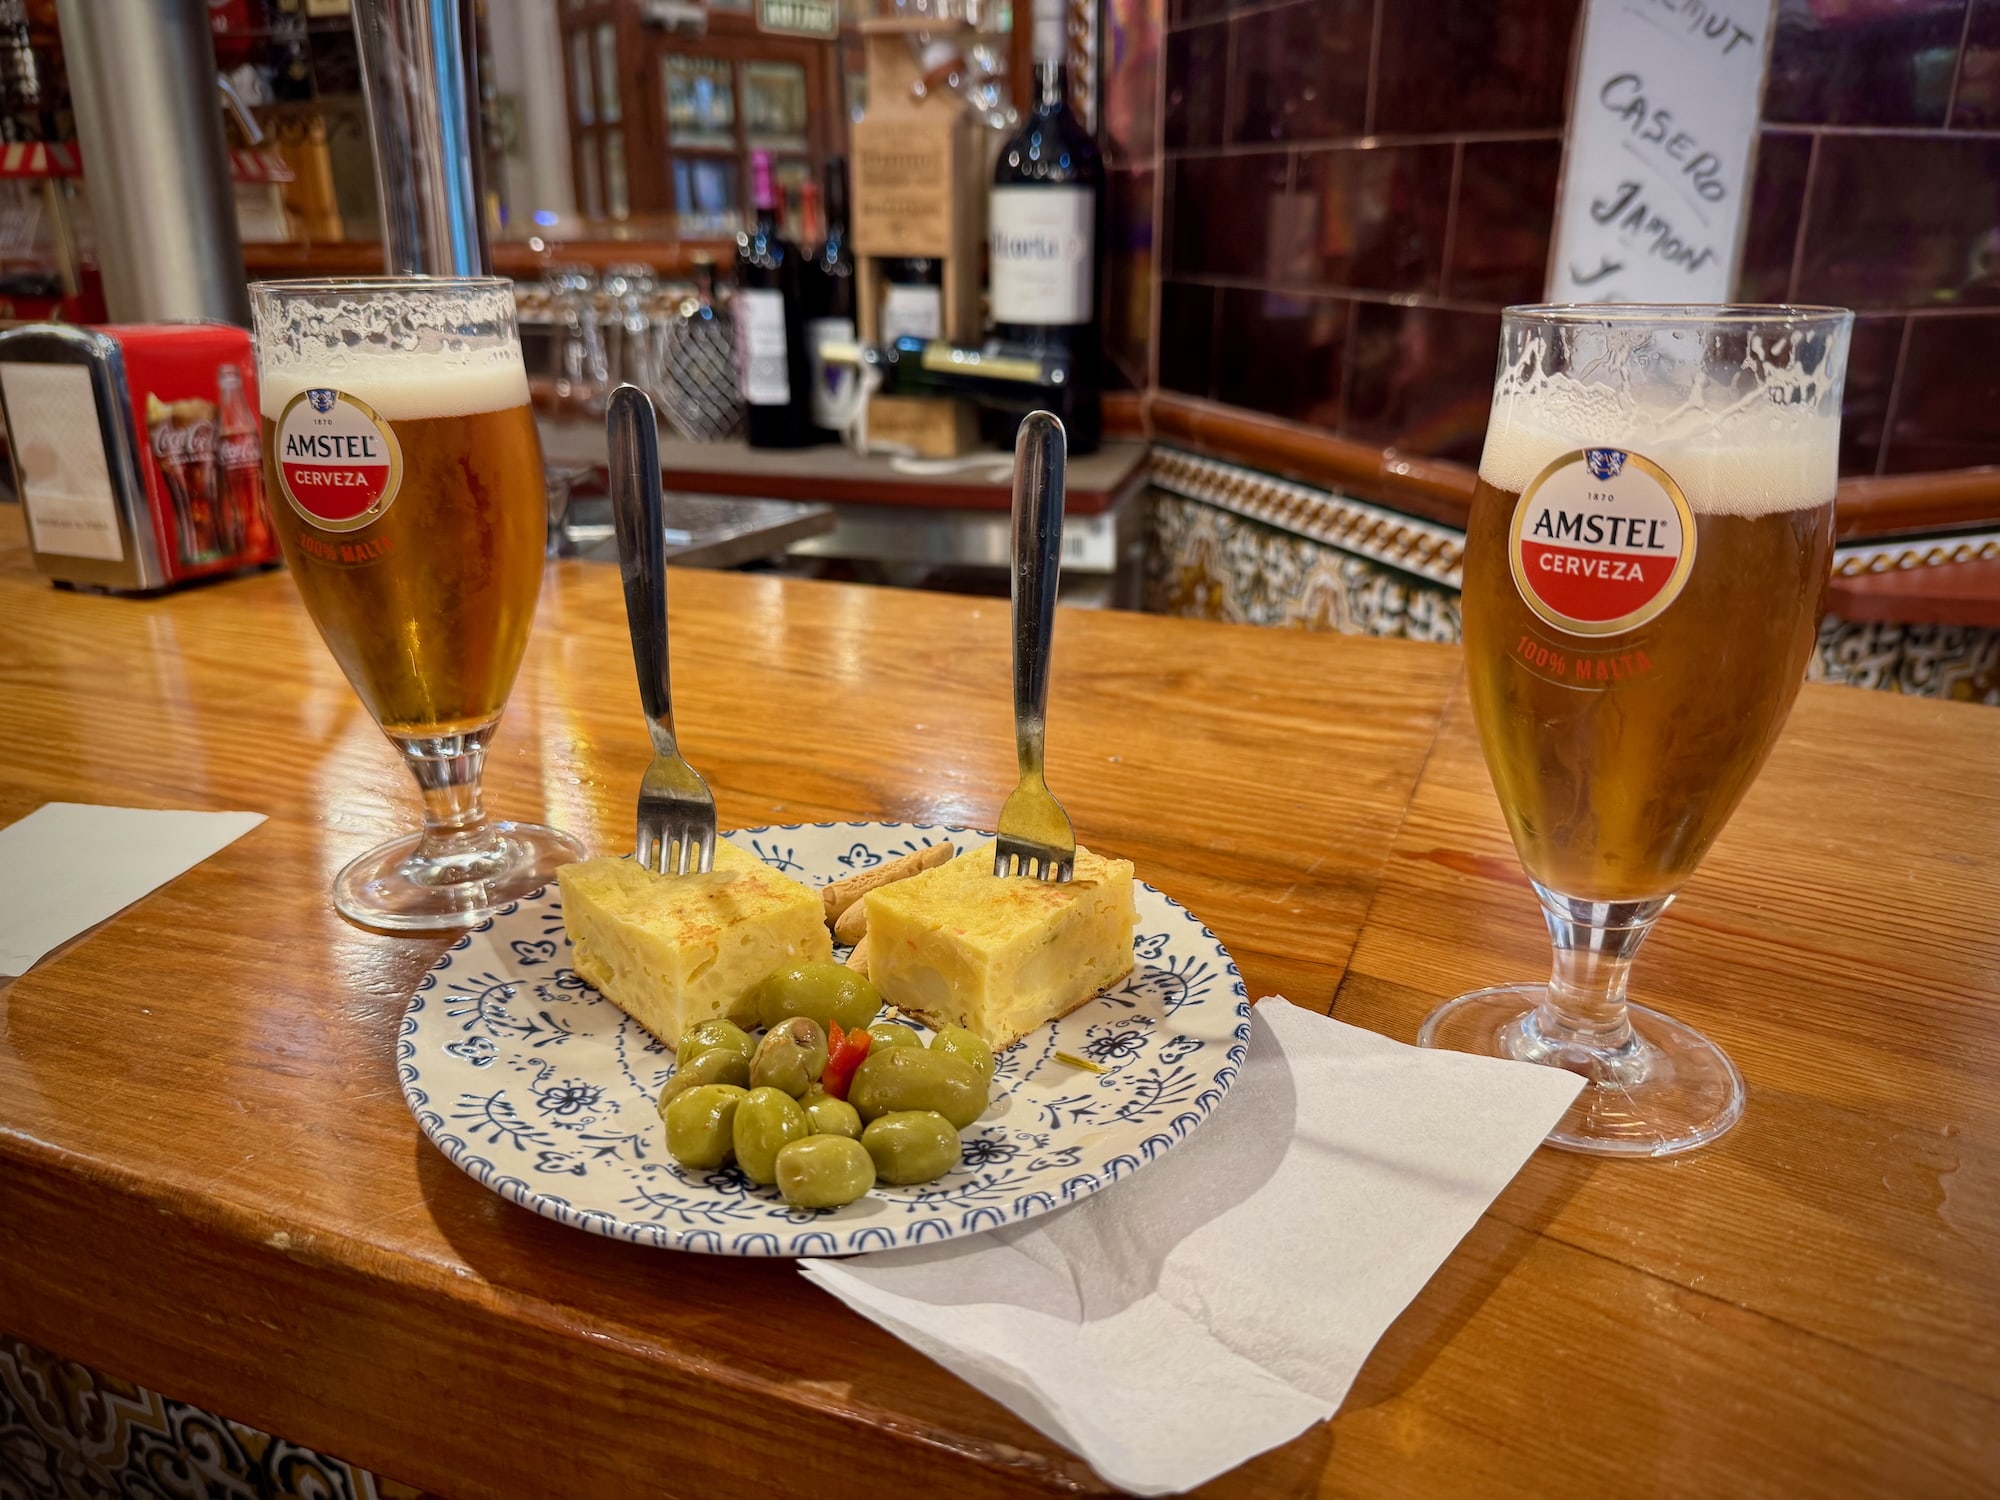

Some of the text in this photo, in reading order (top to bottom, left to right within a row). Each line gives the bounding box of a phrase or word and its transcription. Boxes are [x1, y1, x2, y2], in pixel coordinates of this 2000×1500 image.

[1600, 73, 1727, 203] CASERO
[295, 471, 369, 487] CERVEZA
[1587, 492, 1615, 502] 1870
[301, 533, 396, 562] 100% MALTA
[1539, 553, 1645, 583] CERVEZA
[1516, 636, 1653, 681] 100% MALTA
